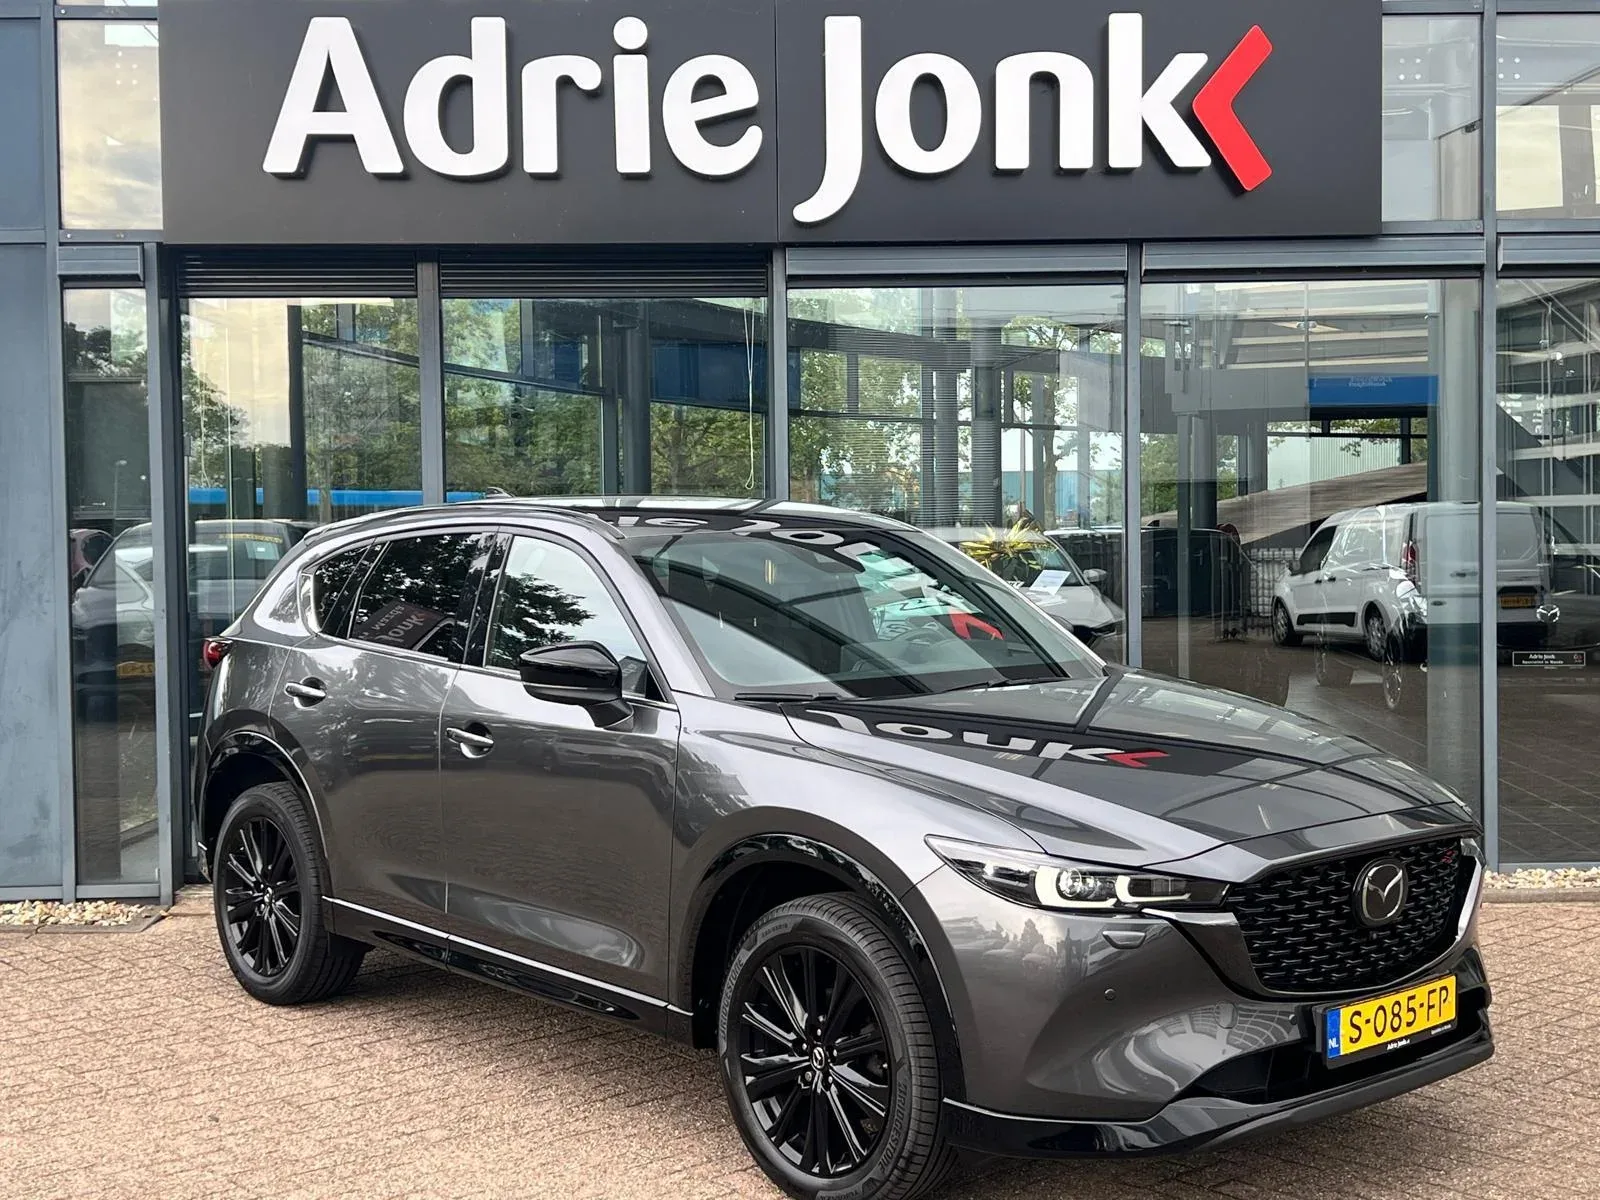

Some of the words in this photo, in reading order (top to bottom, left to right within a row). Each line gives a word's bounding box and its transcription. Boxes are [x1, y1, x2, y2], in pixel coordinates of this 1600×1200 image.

[262, 16, 764, 179] Adrie
[793, 12, 1213, 224] Jonk
[1328, 1037, 1340, 1049] NL
[1348, 985, 1449, 1045] S-085-FP
